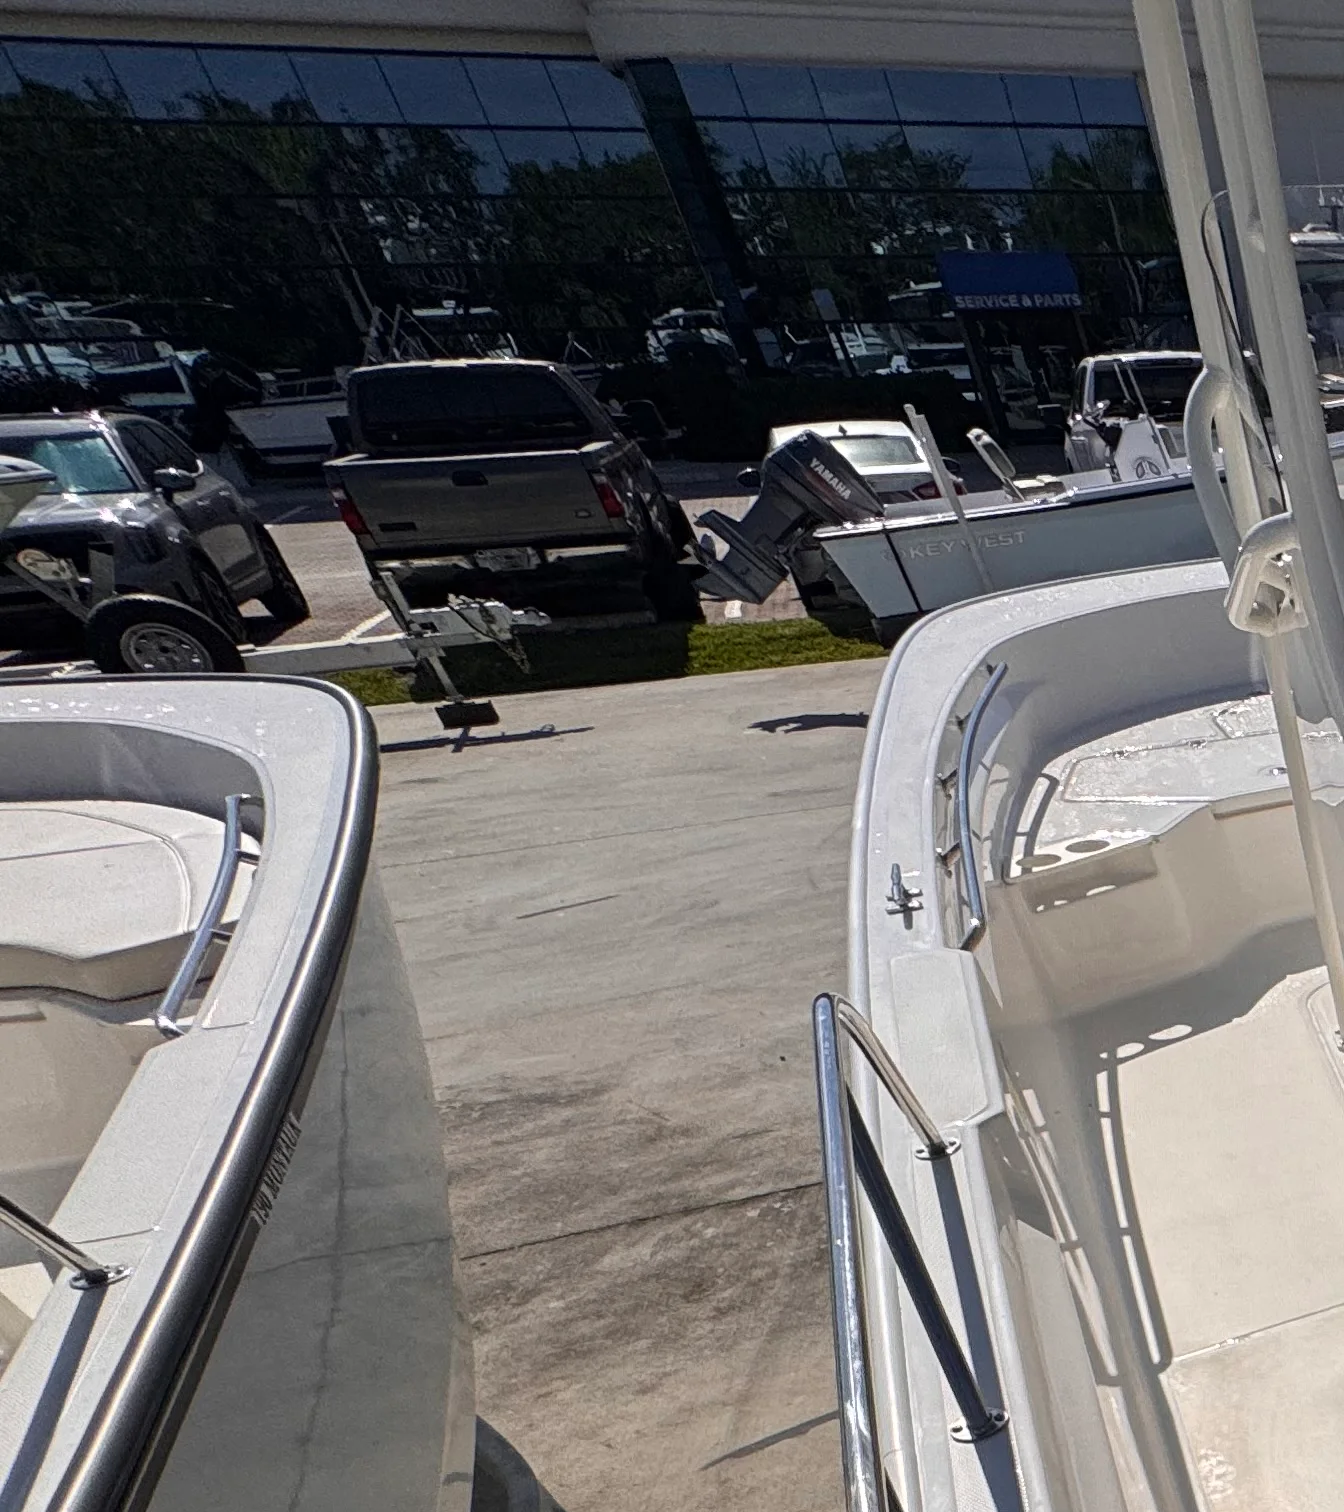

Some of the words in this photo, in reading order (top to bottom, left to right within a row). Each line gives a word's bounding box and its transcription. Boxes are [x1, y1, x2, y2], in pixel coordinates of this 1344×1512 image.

[954, 294, 1020, 309] SERVICE
[1021, 293, 1033, 308] &
[1033, 293, 1081, 308] PARTS
[810, 457, 851, 500] YAMAHA
[910, 541, 955, 560] KEY
